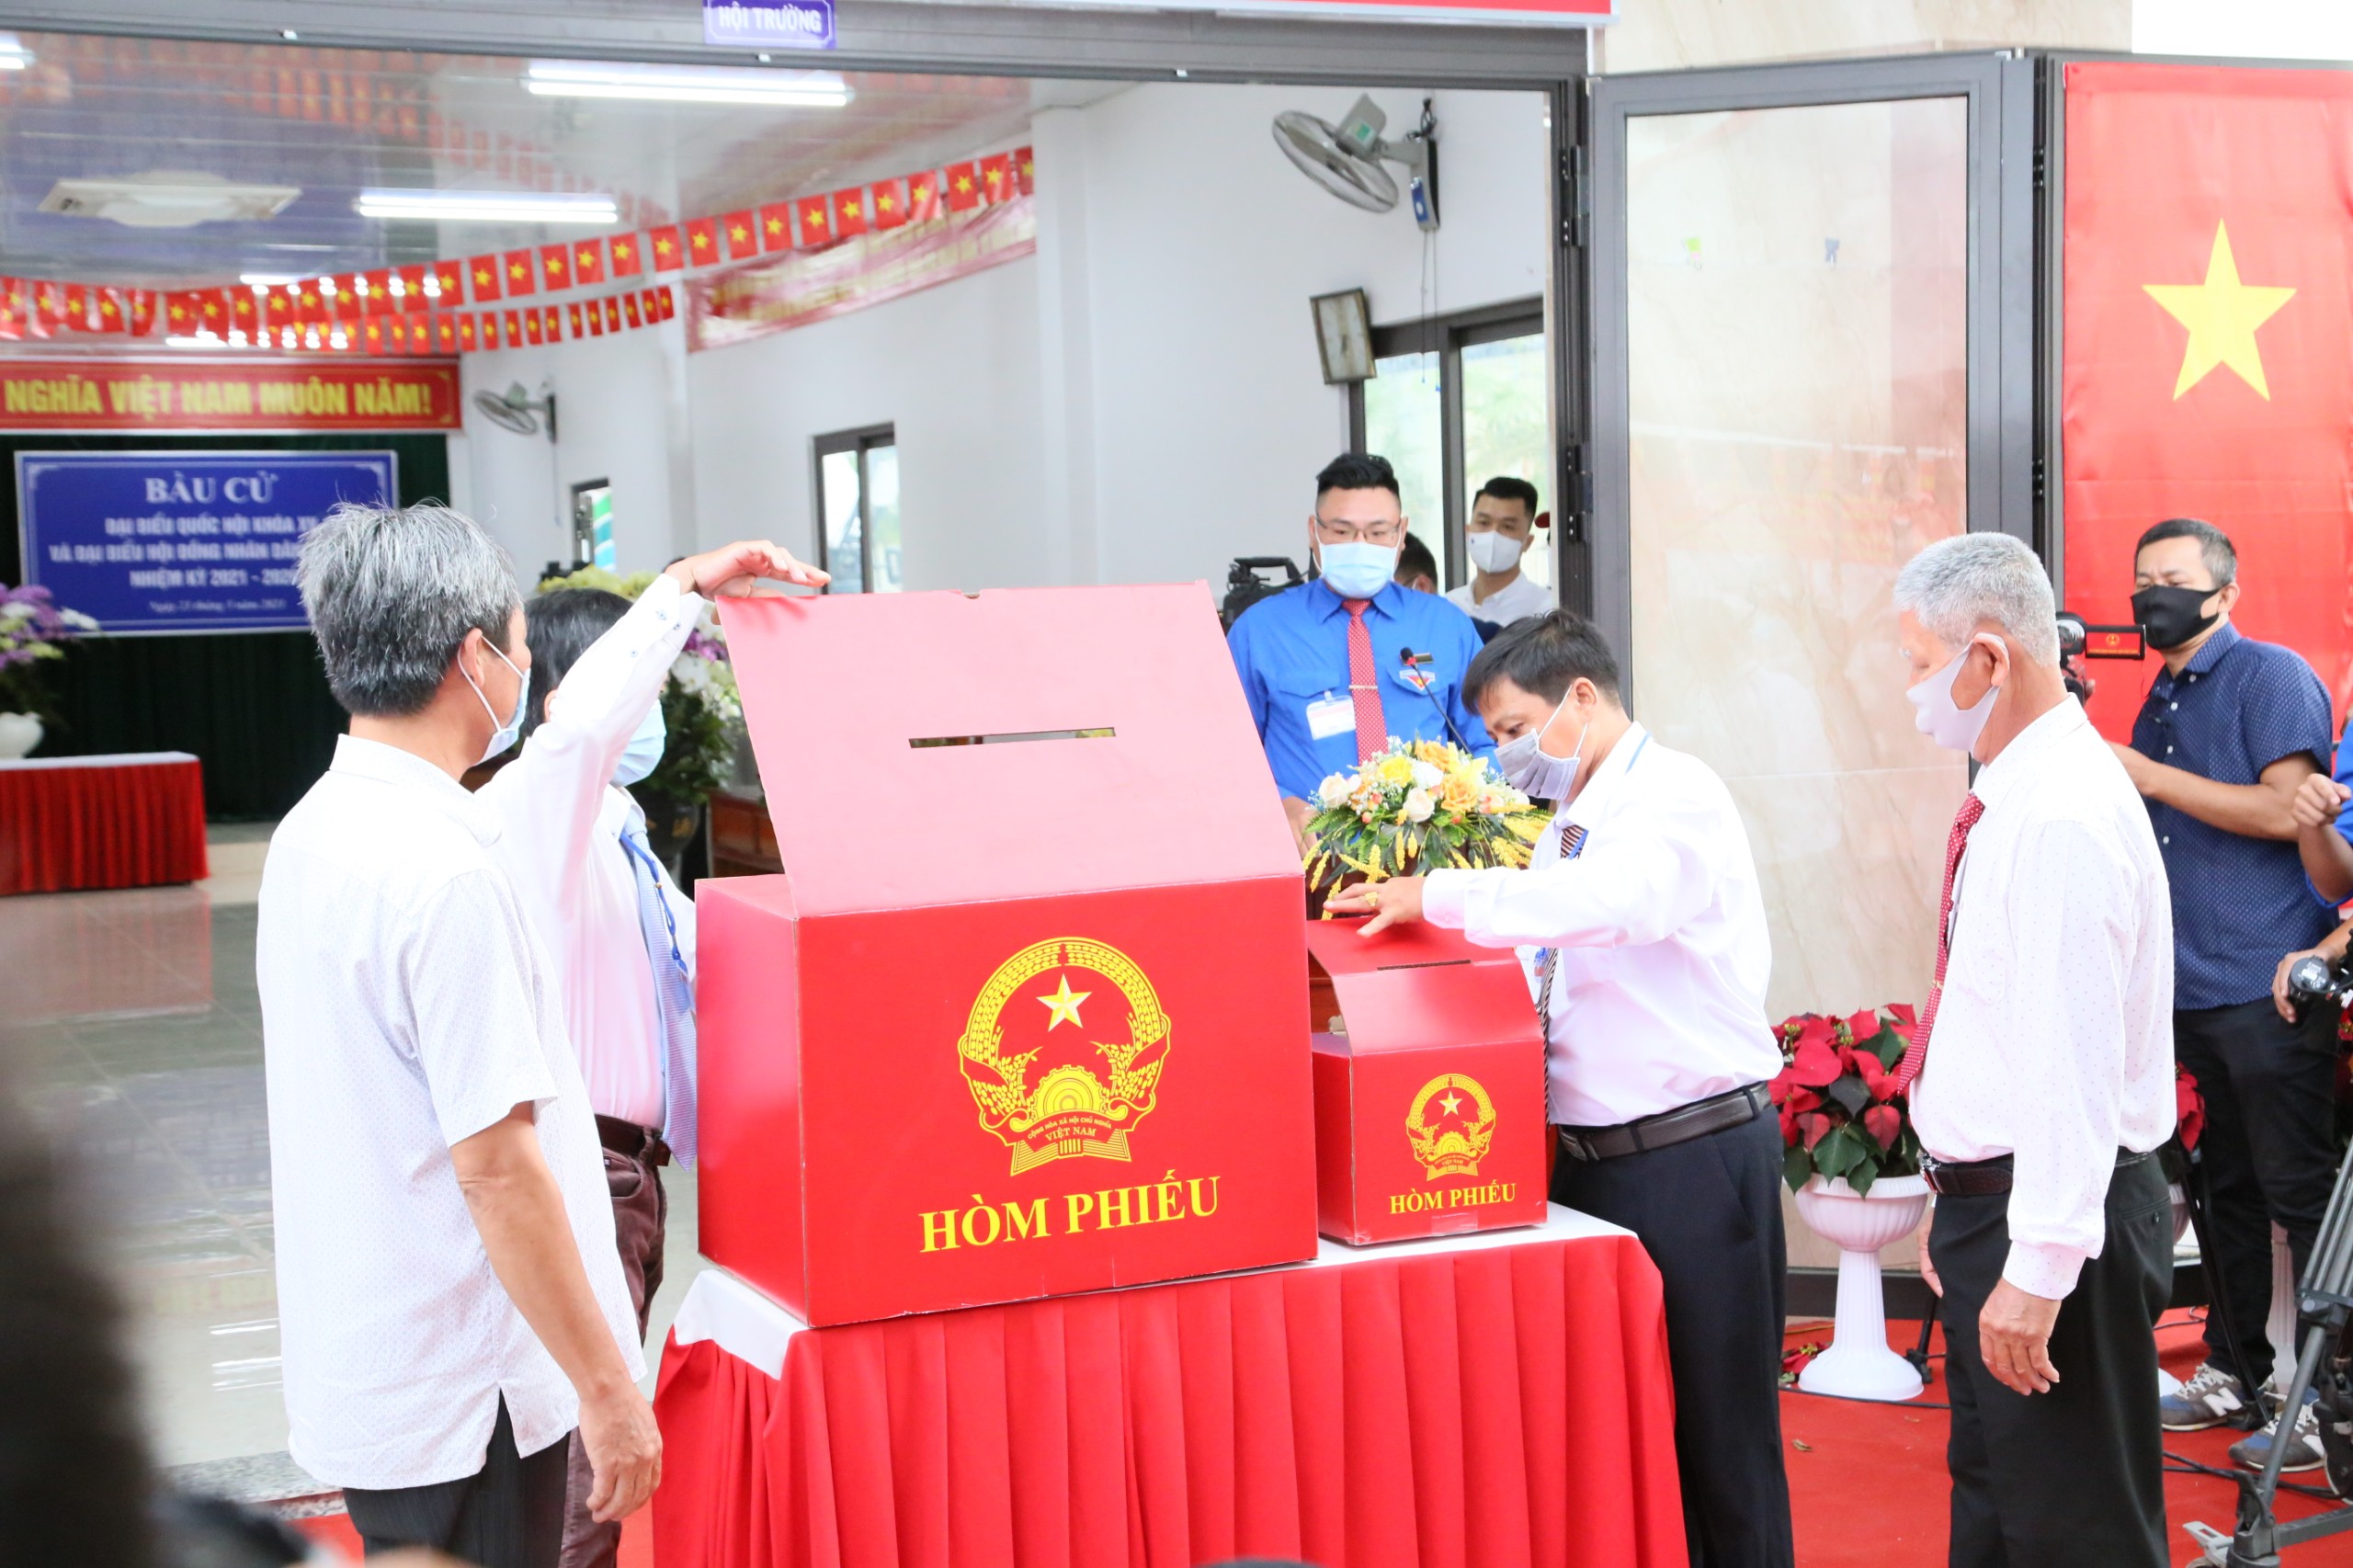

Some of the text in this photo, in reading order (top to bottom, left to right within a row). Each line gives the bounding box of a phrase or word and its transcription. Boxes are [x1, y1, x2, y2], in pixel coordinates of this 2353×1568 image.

[718, 1, 823, 33] HỘI TRƯỜNG
[4, 374, 432, 422] NGHĨA VIỆT NAM MUÔN NĂM!
[144, 470, 278, 504] BẦU CỬ
[1028, 1127, 1044, 1139] CỘNG
[1044, 1120, 1058, 1130] HÒA
[1059, 1117, 1068, 1125] XÃ
[1068, 1115, 1080, 1124] HỘI
[1080, 1115, 1093, 1124] CHỦ
[1045, 1126, 1097, 1141] VIỆT NAM
[918, 1169, 1221, 1253] HÒM PHIẾU
[1389, 1179, 1517, 1214] HÒM PHIẾU
